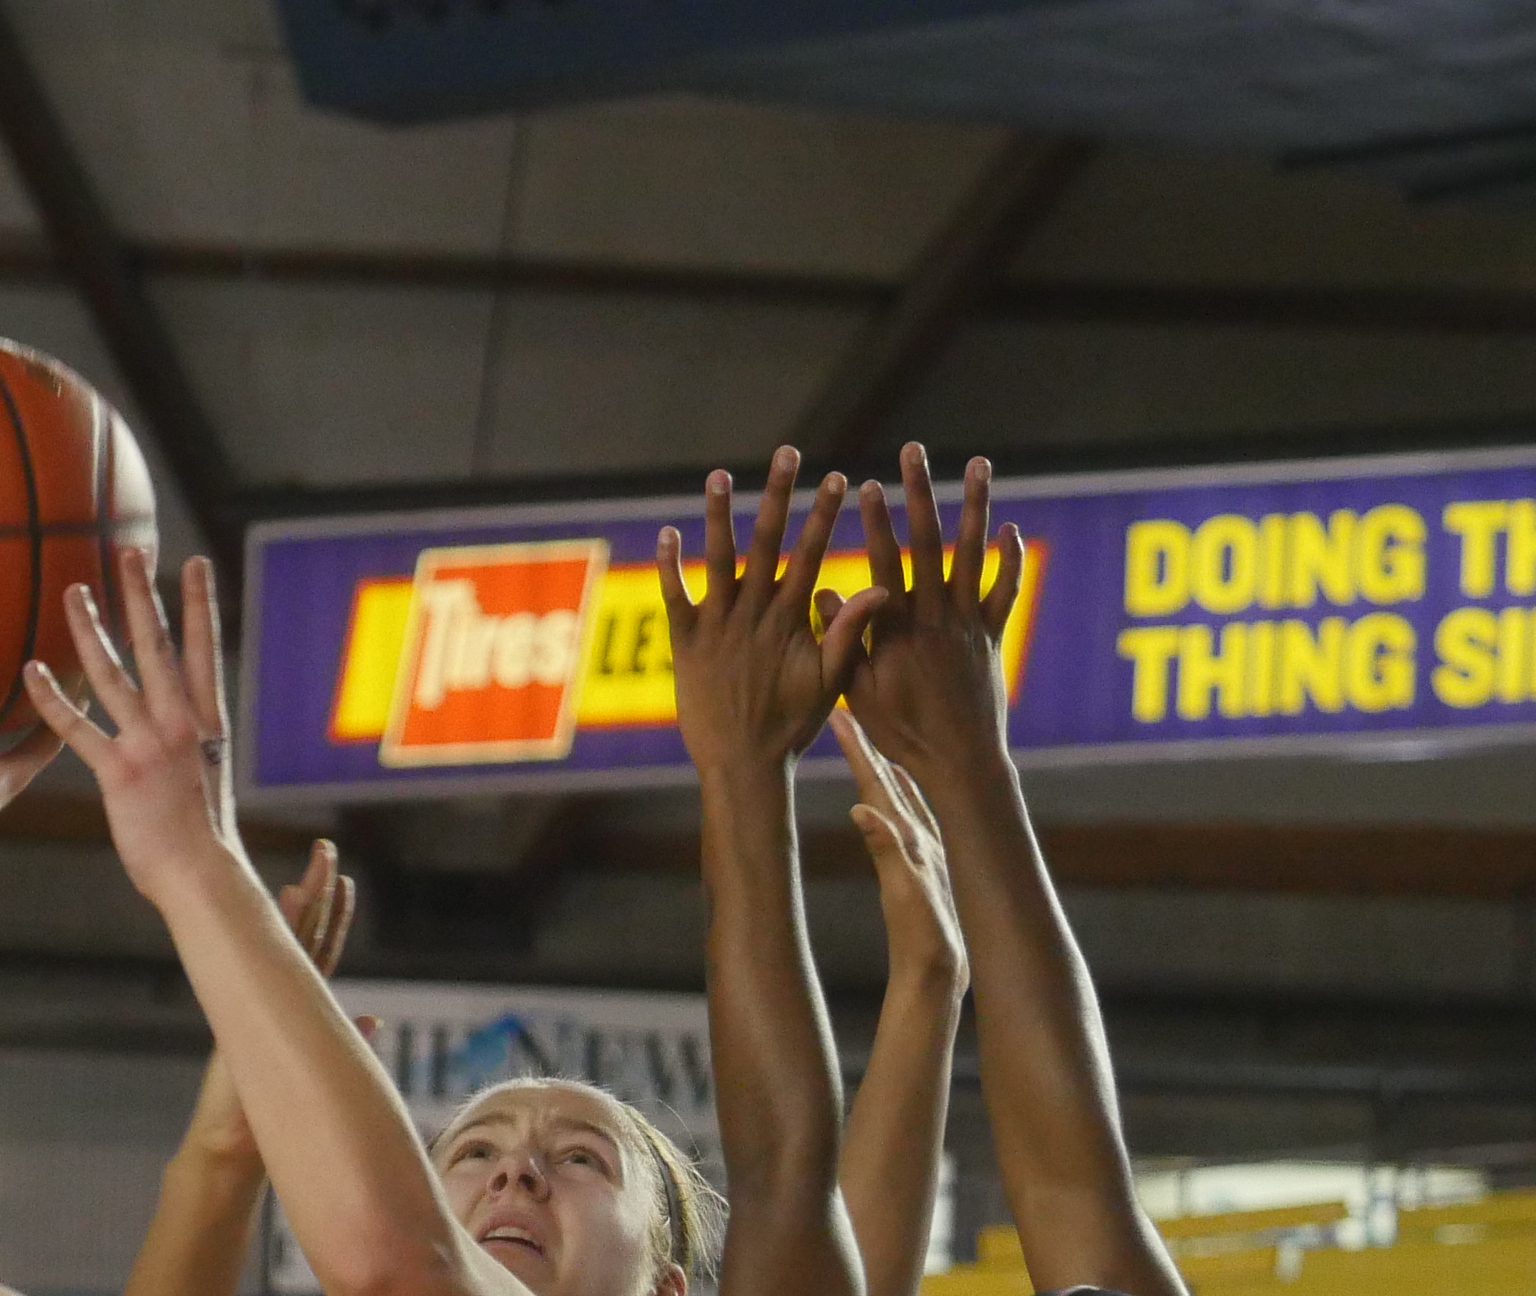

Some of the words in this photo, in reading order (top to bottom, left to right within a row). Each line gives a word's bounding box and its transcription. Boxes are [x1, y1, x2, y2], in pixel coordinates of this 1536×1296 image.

[1124, 502, 1428, 617] DOING
[594, 606, 676, 677] LE
[1117, 611, 1418, 724] THING
